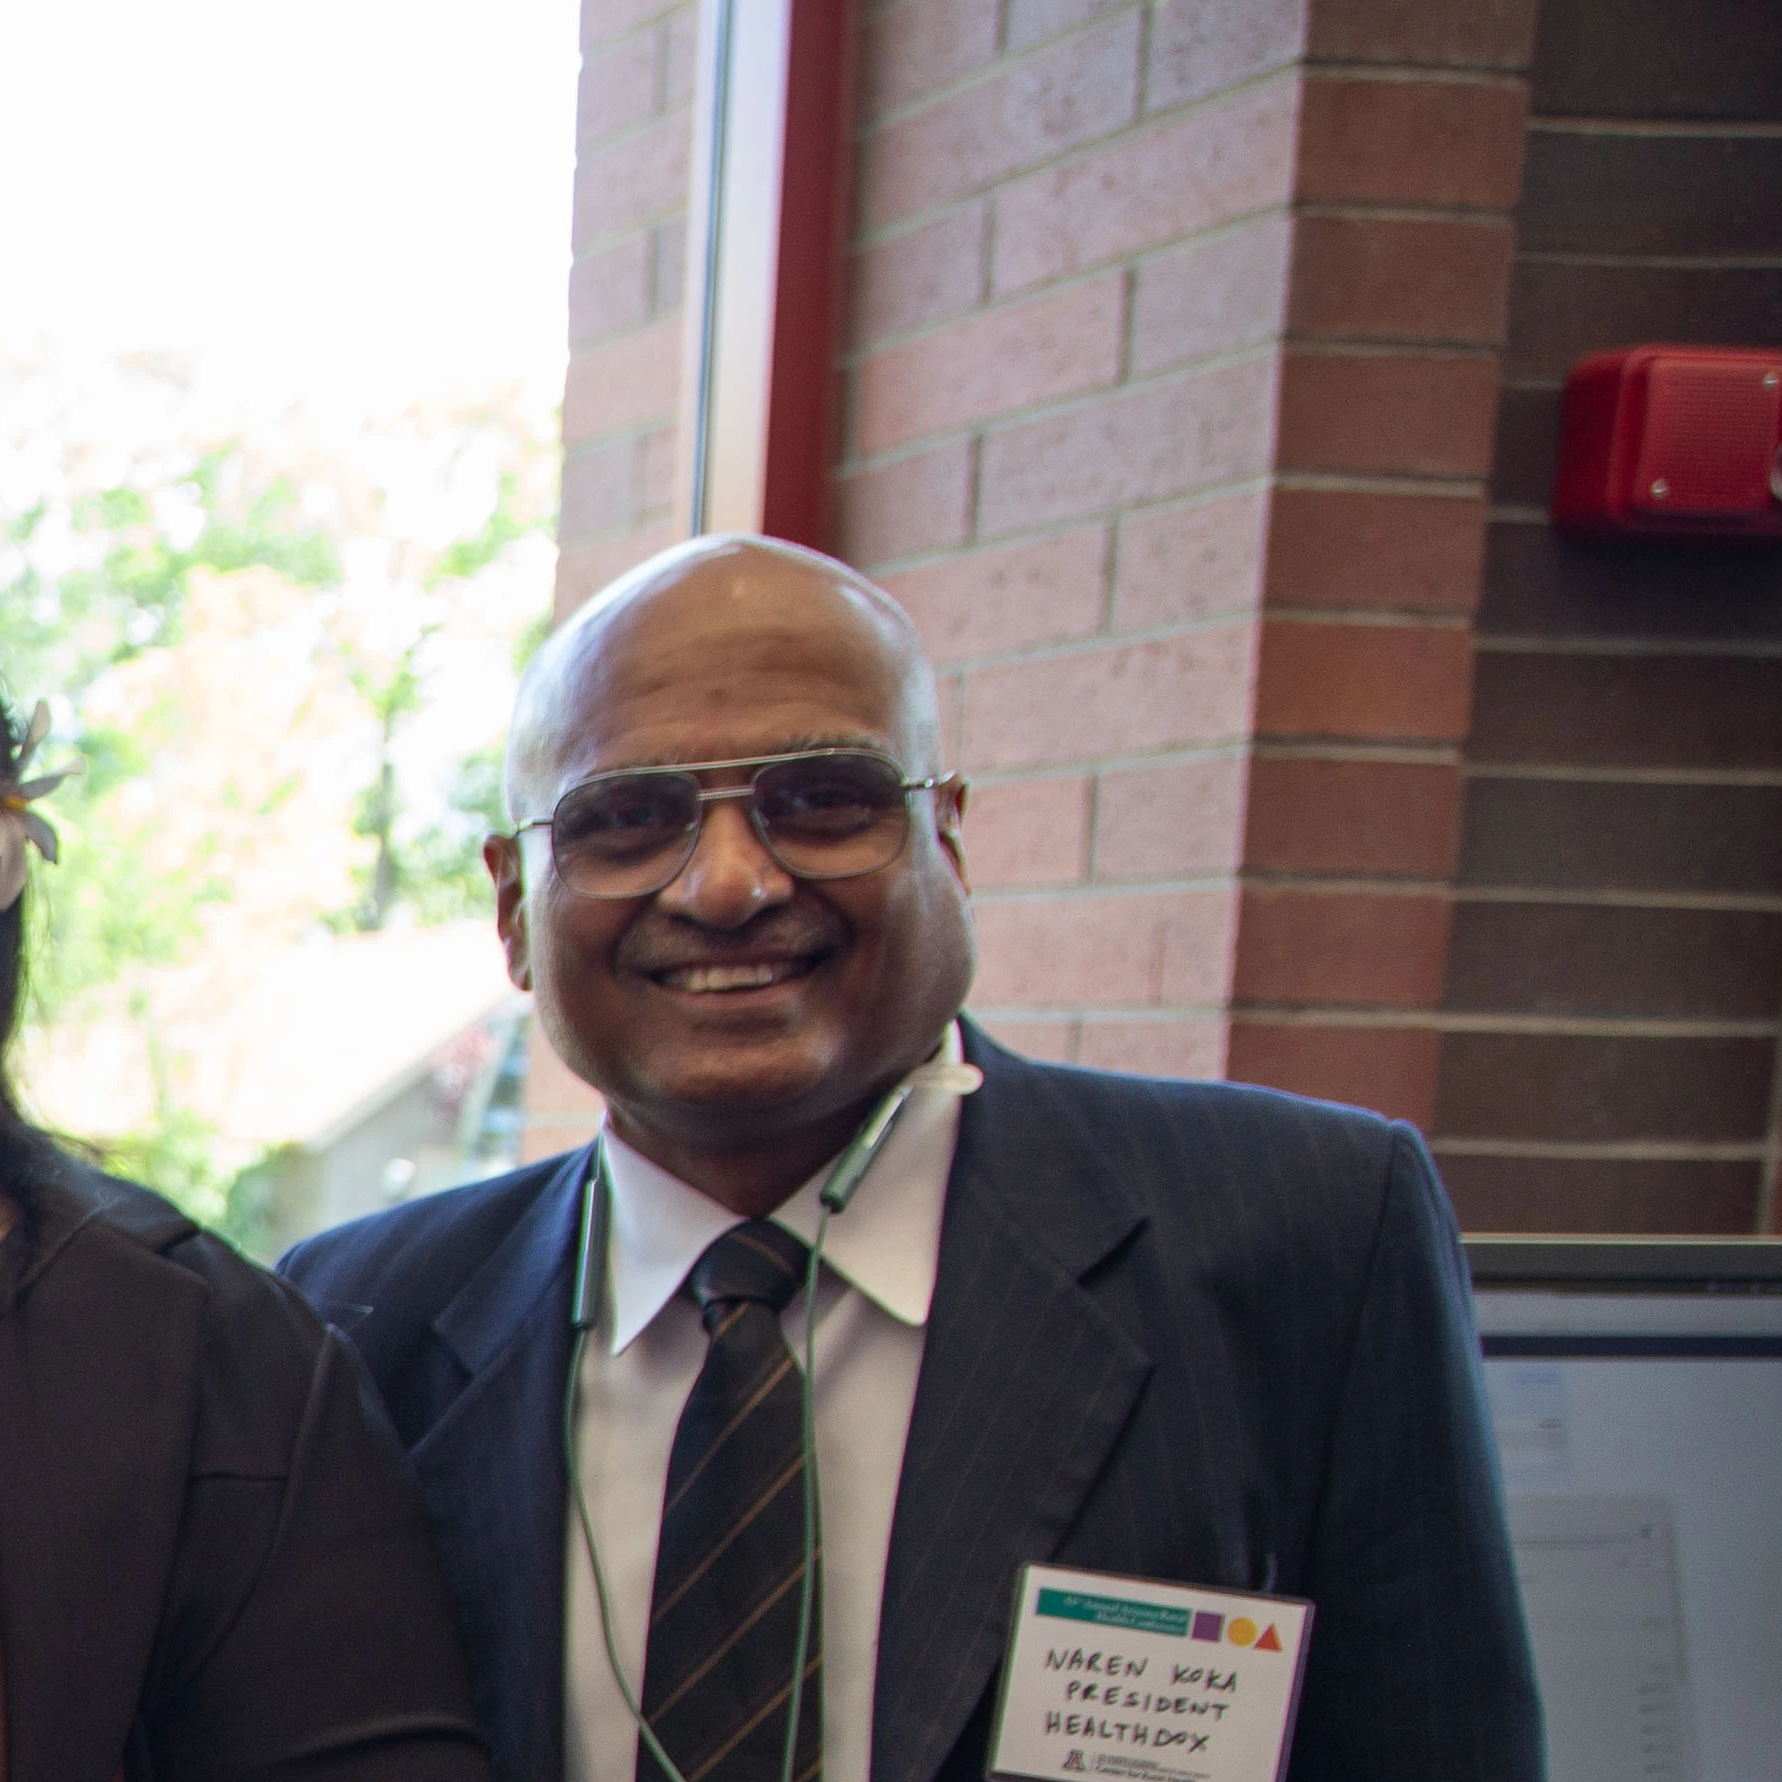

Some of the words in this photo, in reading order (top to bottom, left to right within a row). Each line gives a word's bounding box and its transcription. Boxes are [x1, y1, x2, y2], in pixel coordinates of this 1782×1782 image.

[1044, 1648, 1149, 1678] NAREN
[1169, 1662, 1238, 1692] KOKA
[1065, 1680, 1230, 1722] PRESIDENT
[1043, 1710, 1210, 1754] HEALTHDOX
